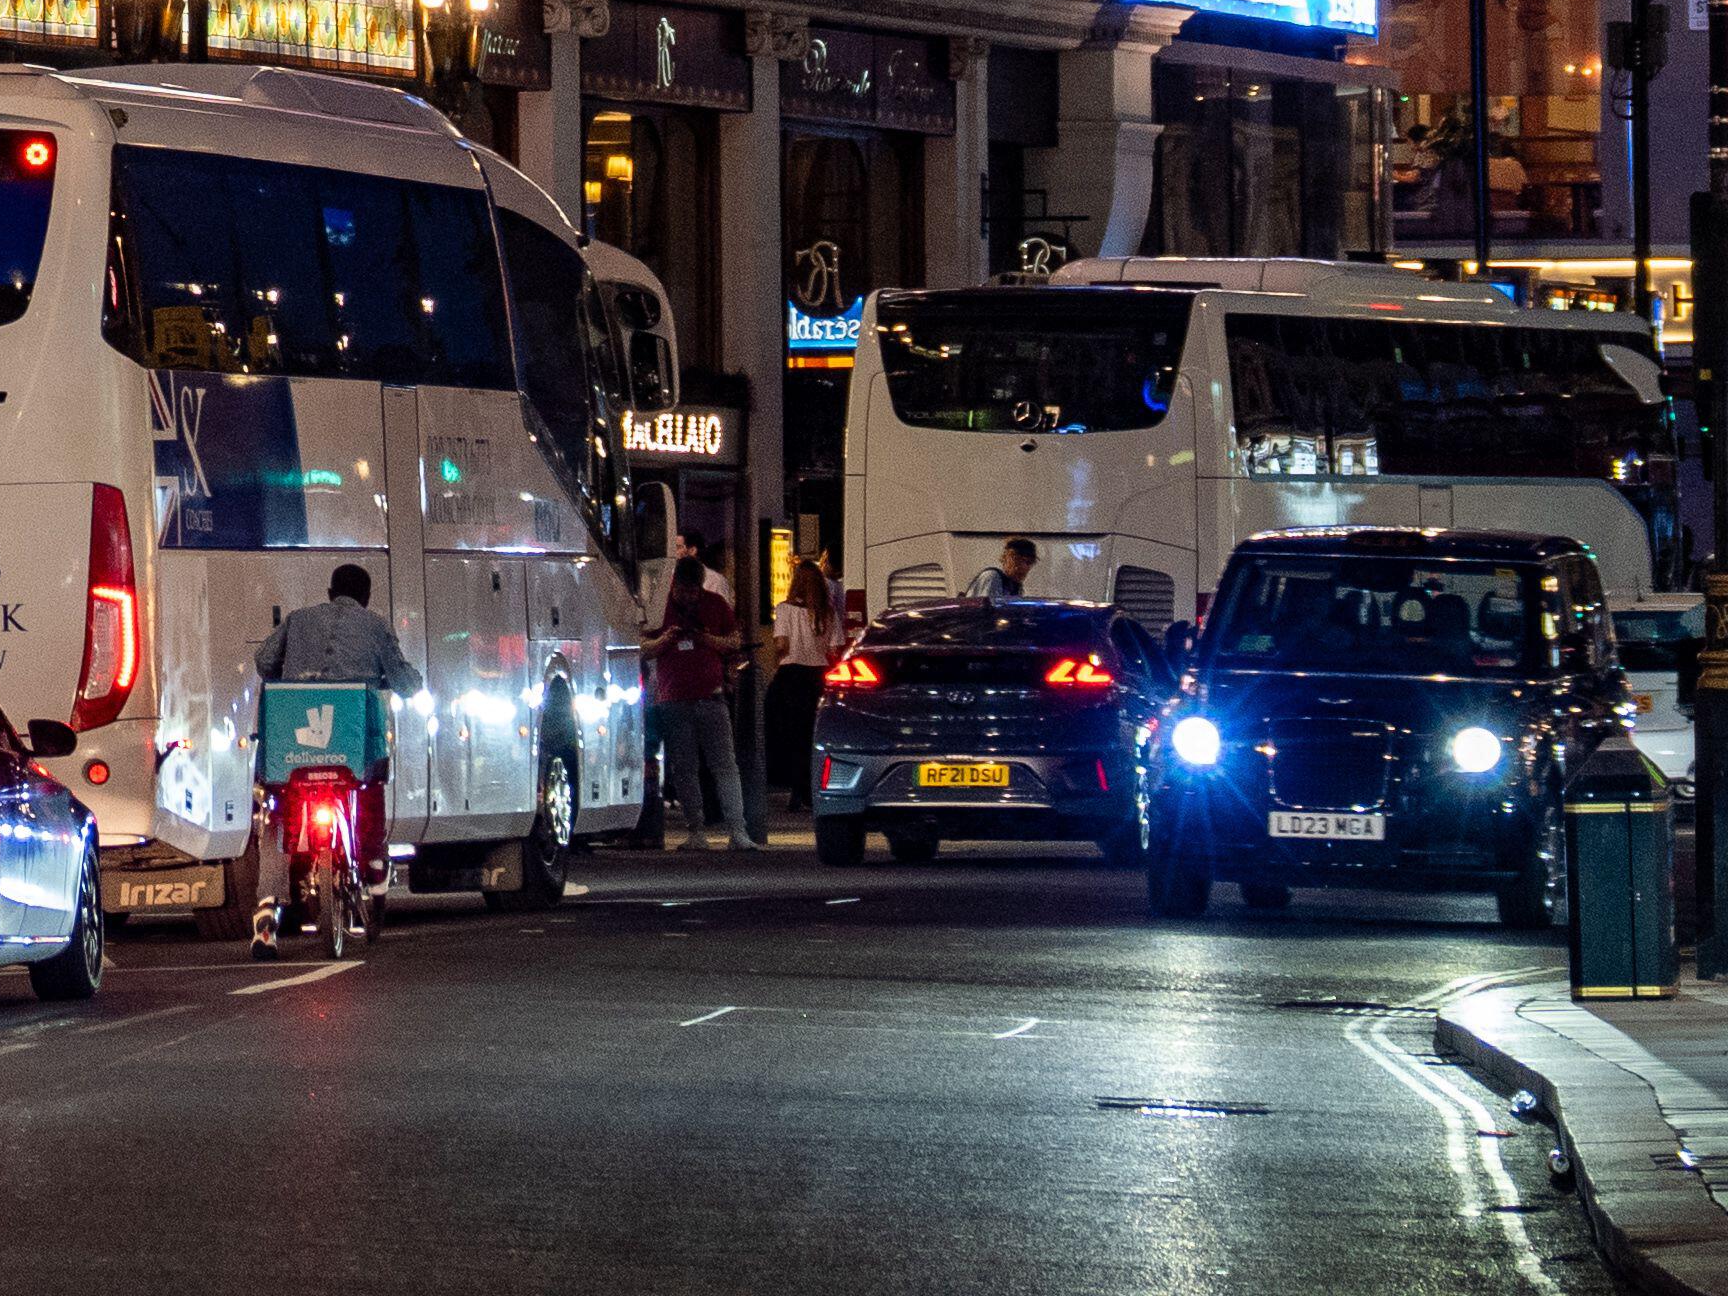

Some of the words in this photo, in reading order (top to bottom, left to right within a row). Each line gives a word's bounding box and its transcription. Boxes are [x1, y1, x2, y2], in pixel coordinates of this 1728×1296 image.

[286, 752, 347, 764] deliveroo
[927, 768, 965, 783] RF21
[971, 768, 1004, 784] DSU
[1278, 815, 1328, 835] LD23
